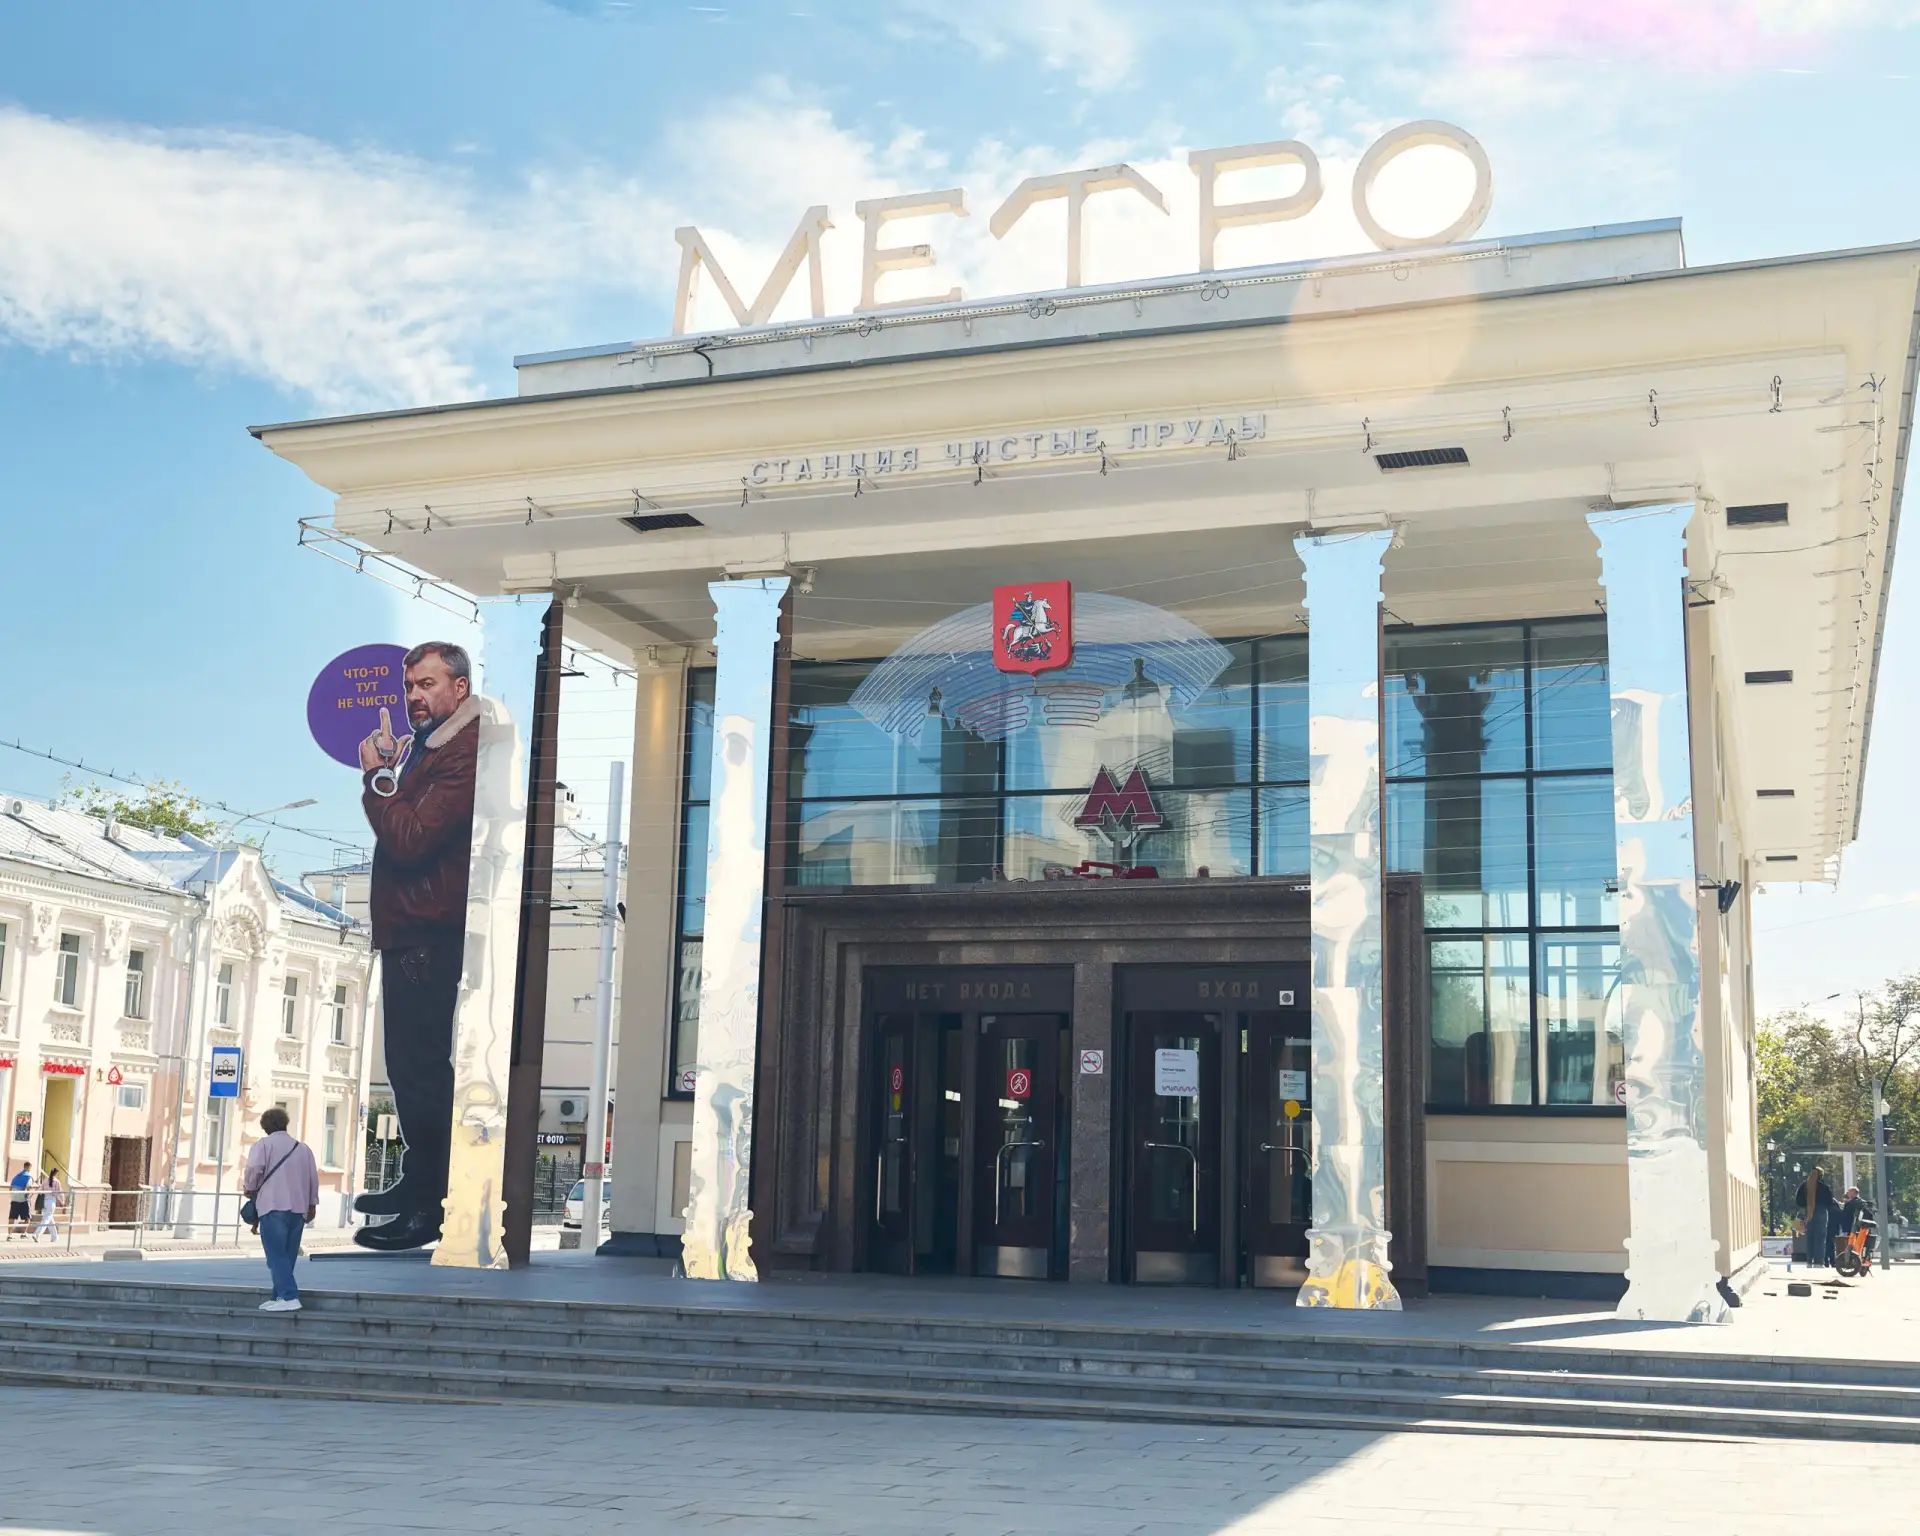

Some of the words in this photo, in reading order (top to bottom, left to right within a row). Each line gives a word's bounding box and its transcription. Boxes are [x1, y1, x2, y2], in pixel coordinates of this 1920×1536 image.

[673, 119, 1493, 336] МЕТРО
[751, 448, 919, 484] СТАНЦИЯ
[945, 428, 1099, 466] ЧИСТЫЕ
[1127, 413, 1267, 448] ПРУДЫ
[343, 666, 389, 679] ЧТО-ТО
[356, 681, 379, 693] ТУТ
[337, 698, 353, 709] НЕ
[356, 694, 398, 708] ЧИСТО
[905, 982, 946, 1000] НЕТ
[960, 982, 1033, 1000] ВХОДА
[1198, 981, 1259, 999] ВХОД
[546, 1134, 564, 1144] ФОТО
